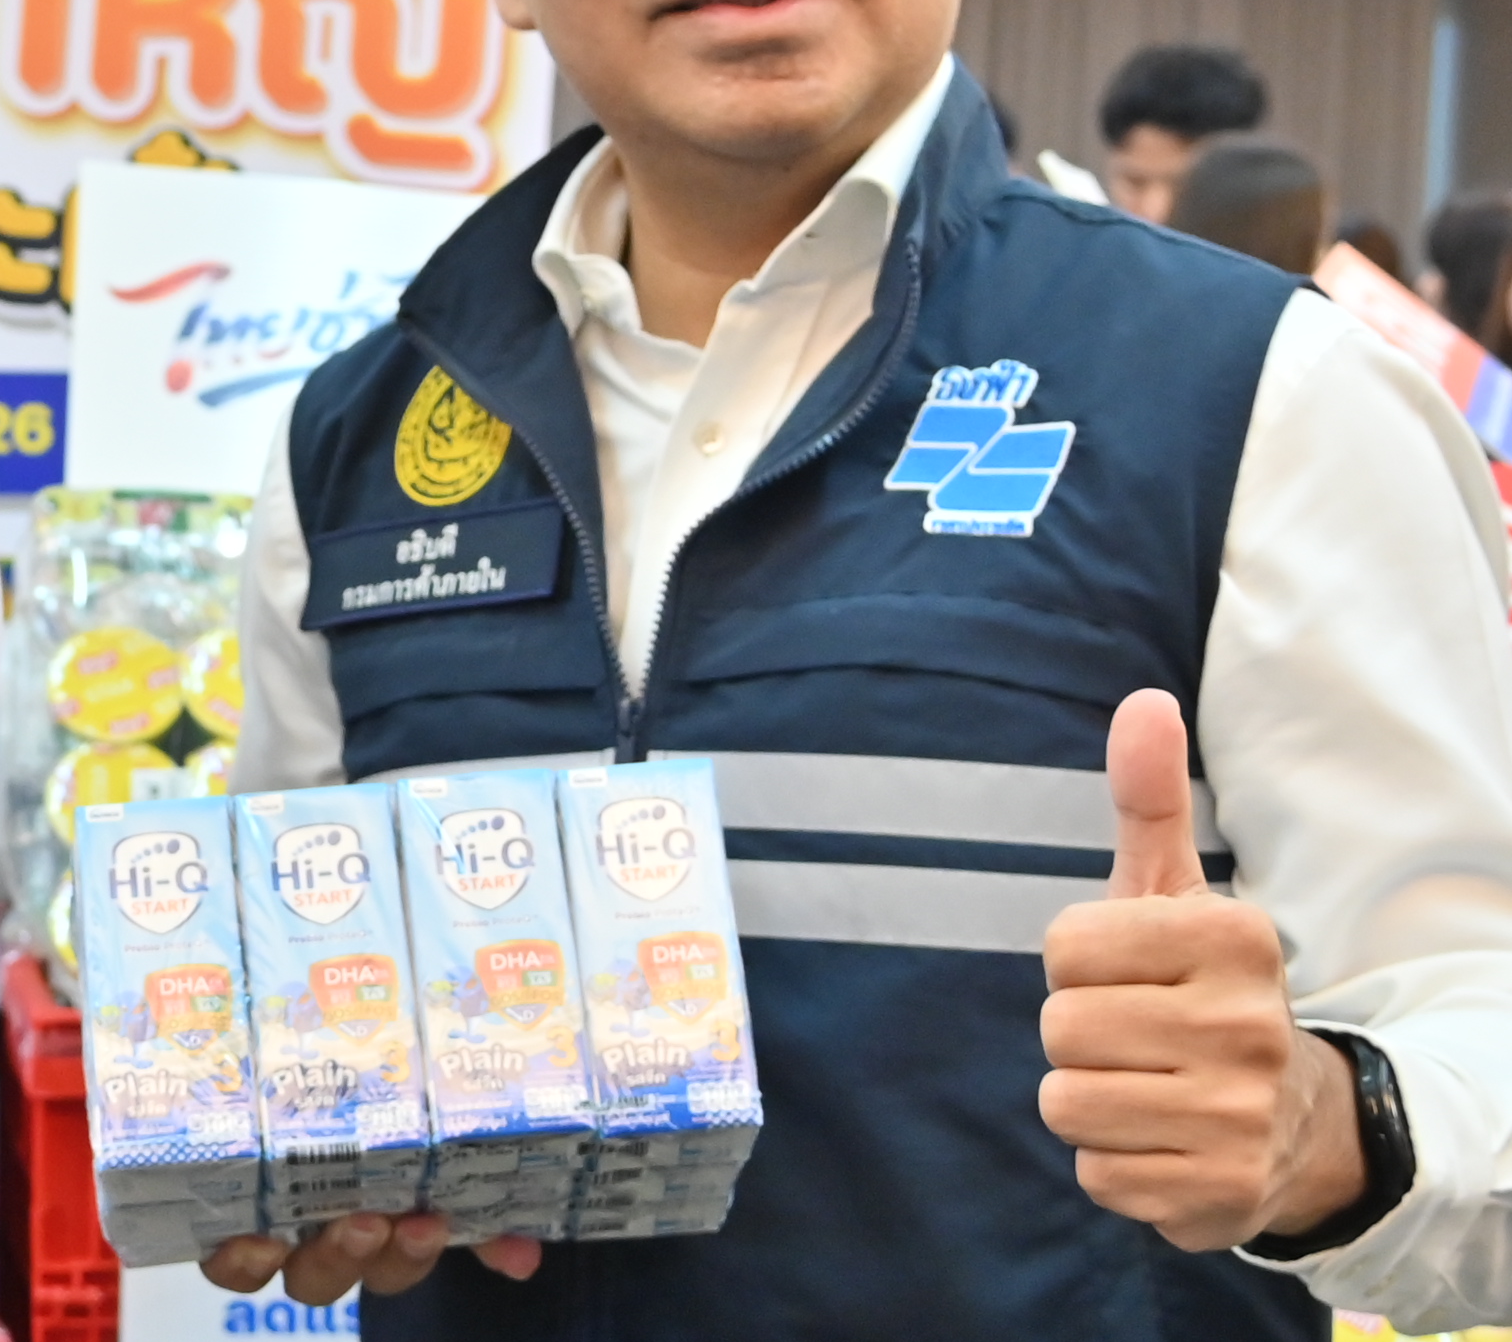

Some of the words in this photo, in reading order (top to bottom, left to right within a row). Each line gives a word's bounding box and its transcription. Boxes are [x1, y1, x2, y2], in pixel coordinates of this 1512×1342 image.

[434, 836, 536, 876] Hi-Q
[595, 826, 697, 867] Hi-Q
[108, 860, 210, 899] Hi-Q
[270, 851, 372, 891] Hi-Q
[458, 873, 517, 892] START
[619, 864, 678, 883] START
[131, 898, 192, 915] START
[294, 889, 353, 907] START
[489, 950, 542, 972] DHA
[651, 942, 704, 964] DHA
[159, 976, 210, 998] DHA
[323, 965, 376, 986] DHA
[546, 1025, 578, 1068] 3
[601, 1038, 688, 1073] Plain
[709, 1020, 743, 1063] 3
[214, 1052, 243, 1092] 3
[272, 1060, 357, 1095] Plain
[379, 1041, 411, 1083] 3
[438, 1043, 524, 1079] Plain
[104, 1069, 189, 1104] Plain
